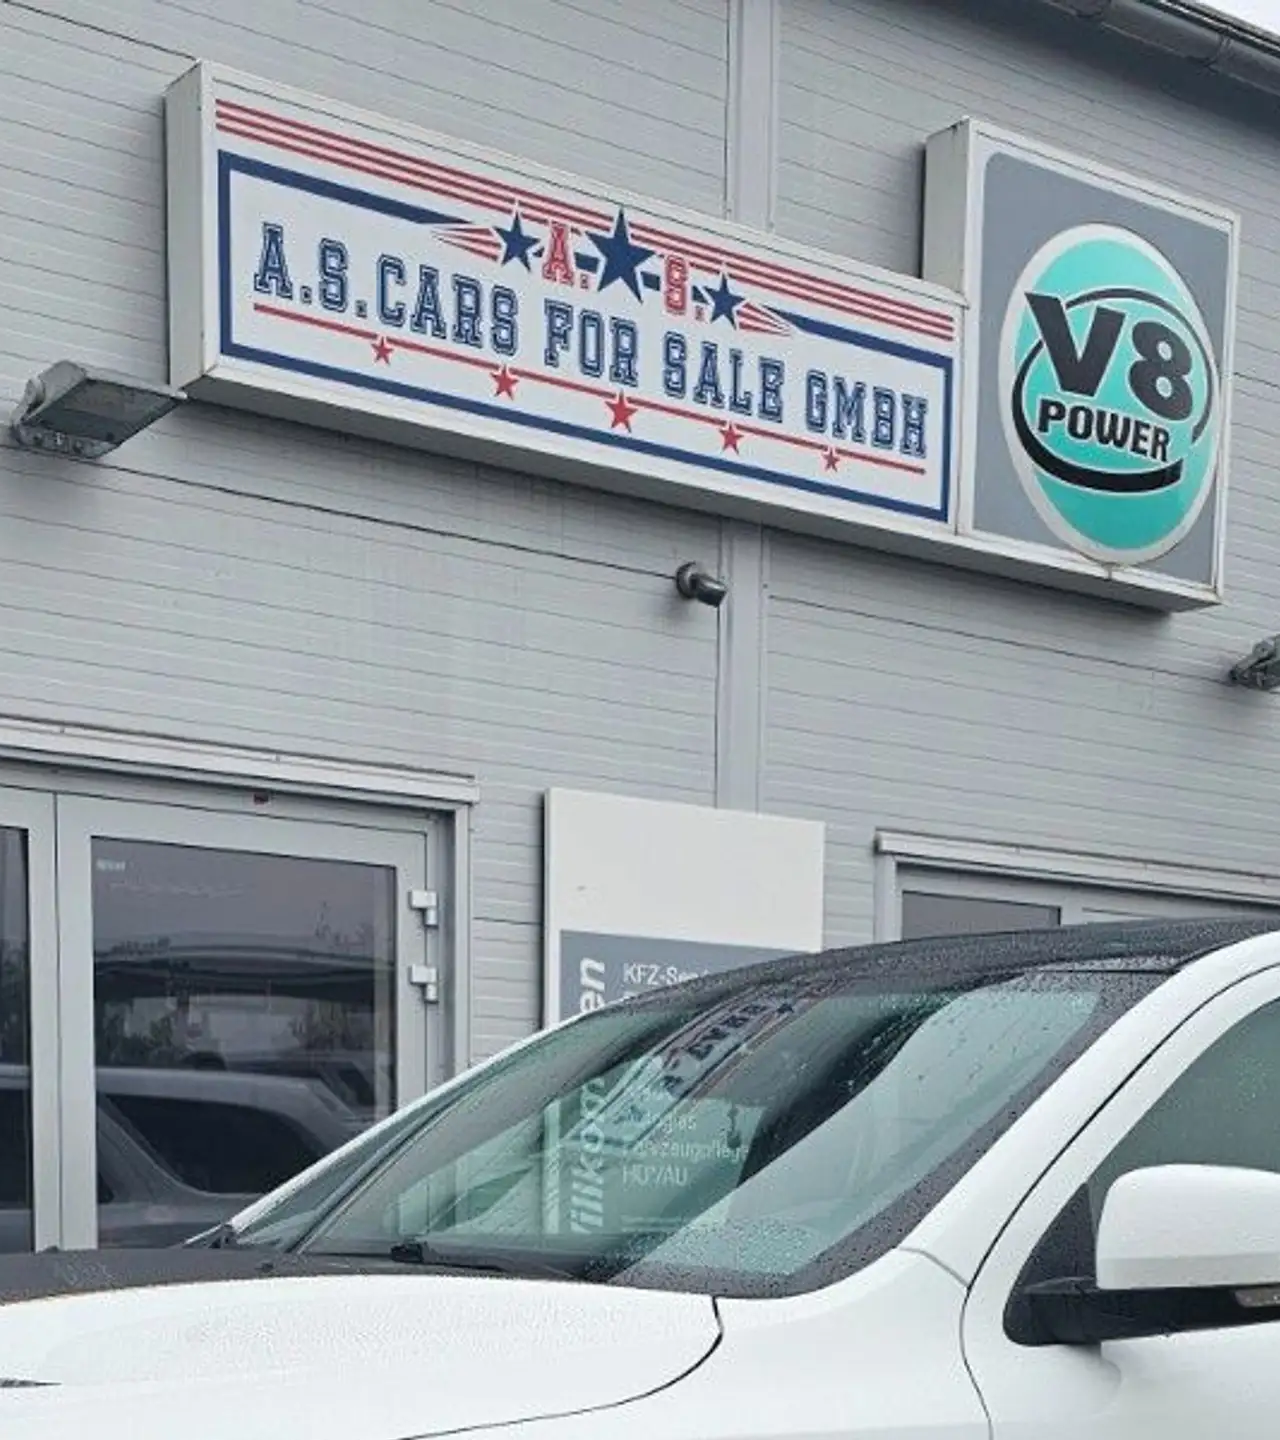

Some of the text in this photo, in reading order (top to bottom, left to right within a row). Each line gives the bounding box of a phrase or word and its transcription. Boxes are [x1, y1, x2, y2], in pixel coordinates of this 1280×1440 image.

[544, 297, 639, 388] FOR
[663, 330, 785, 424] SALE
[805, 369, 928, 459] GMBH
[1025, 292, 1193, 421] V8
[1037, 399, 1171, 463] POWER
